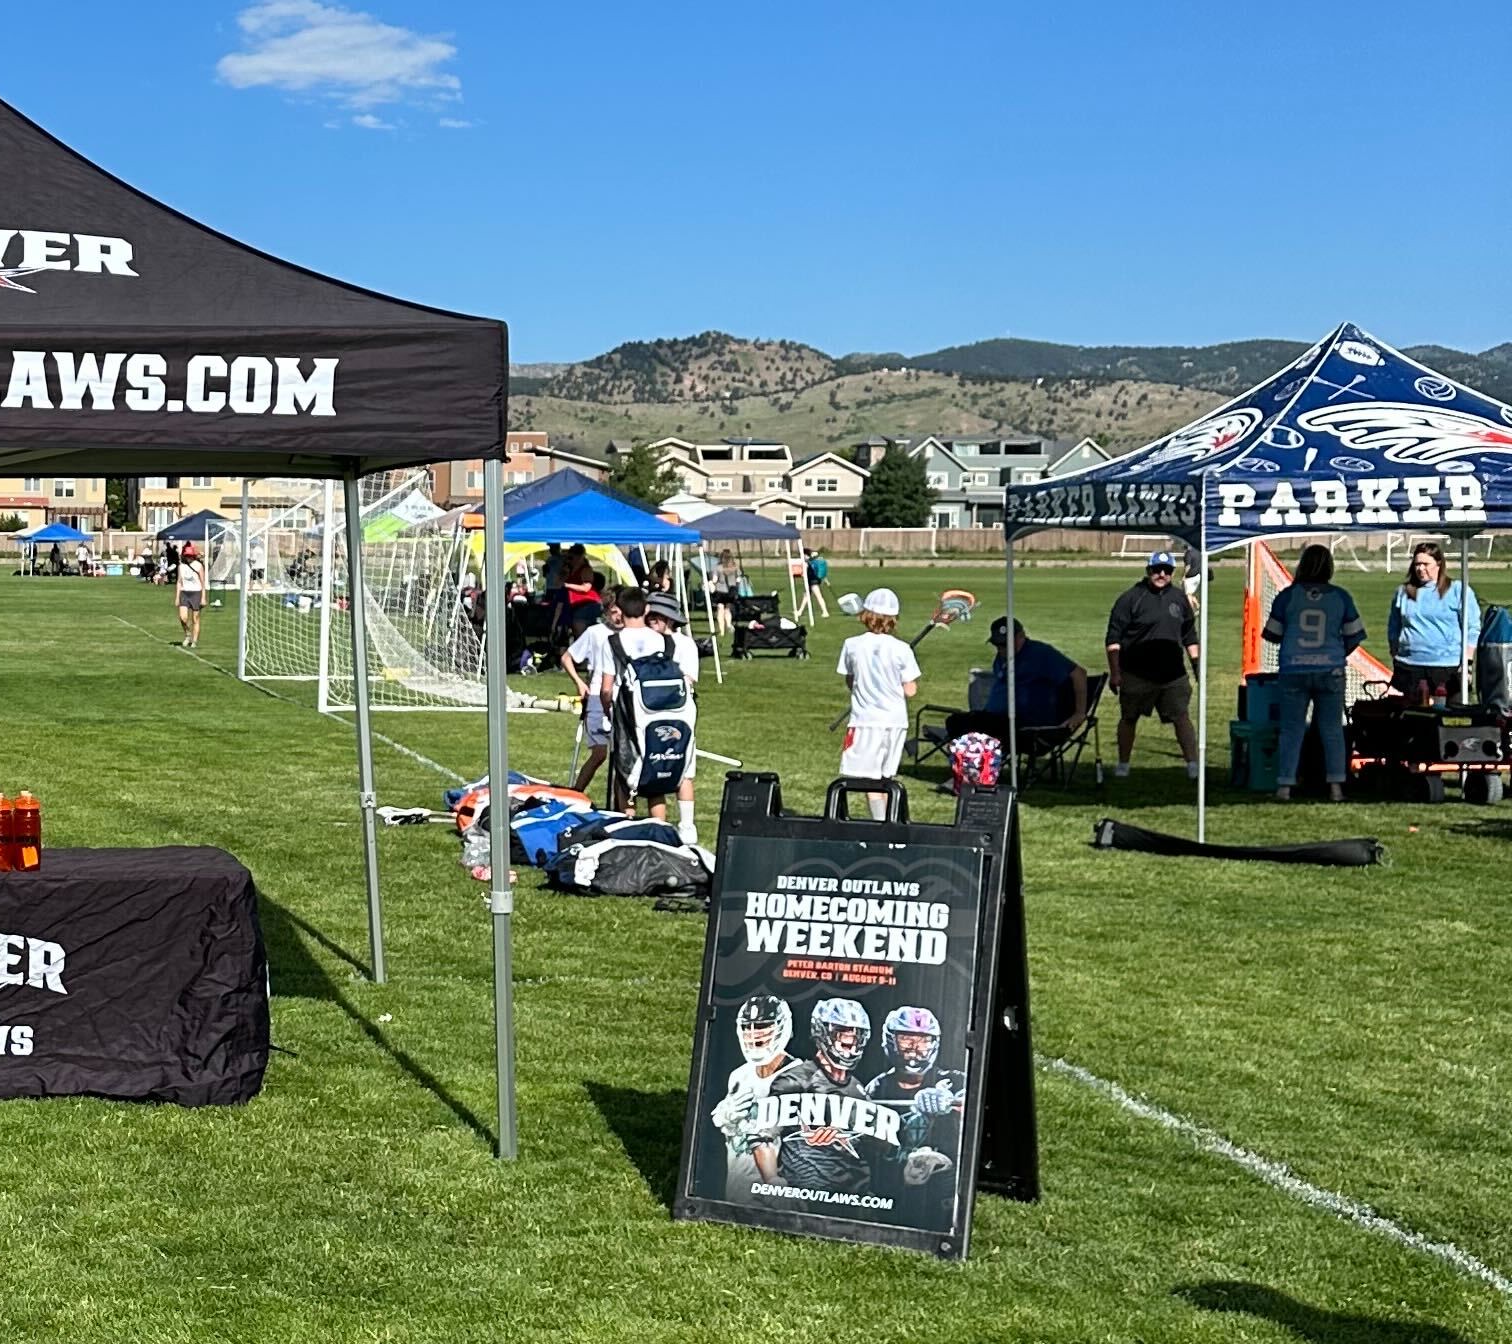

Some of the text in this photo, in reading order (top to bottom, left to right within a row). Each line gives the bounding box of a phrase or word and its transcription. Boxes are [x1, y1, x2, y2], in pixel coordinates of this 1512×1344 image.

[1217, 474, 1488, 527] PARKER
[1298, 608, 1327, 648] 9
[777, 875, 920, 897] DENVER OUTLAWS
[745, 892, 950, 929] HOMECOMING
[744, 918, 948, 965] WEEKEND
[787, 959, 814, 969] PETER
[755, 1092, 901, 1146] DENVER
[751, 1183, 894, 1209] DENVEROUTLAWS.COM
